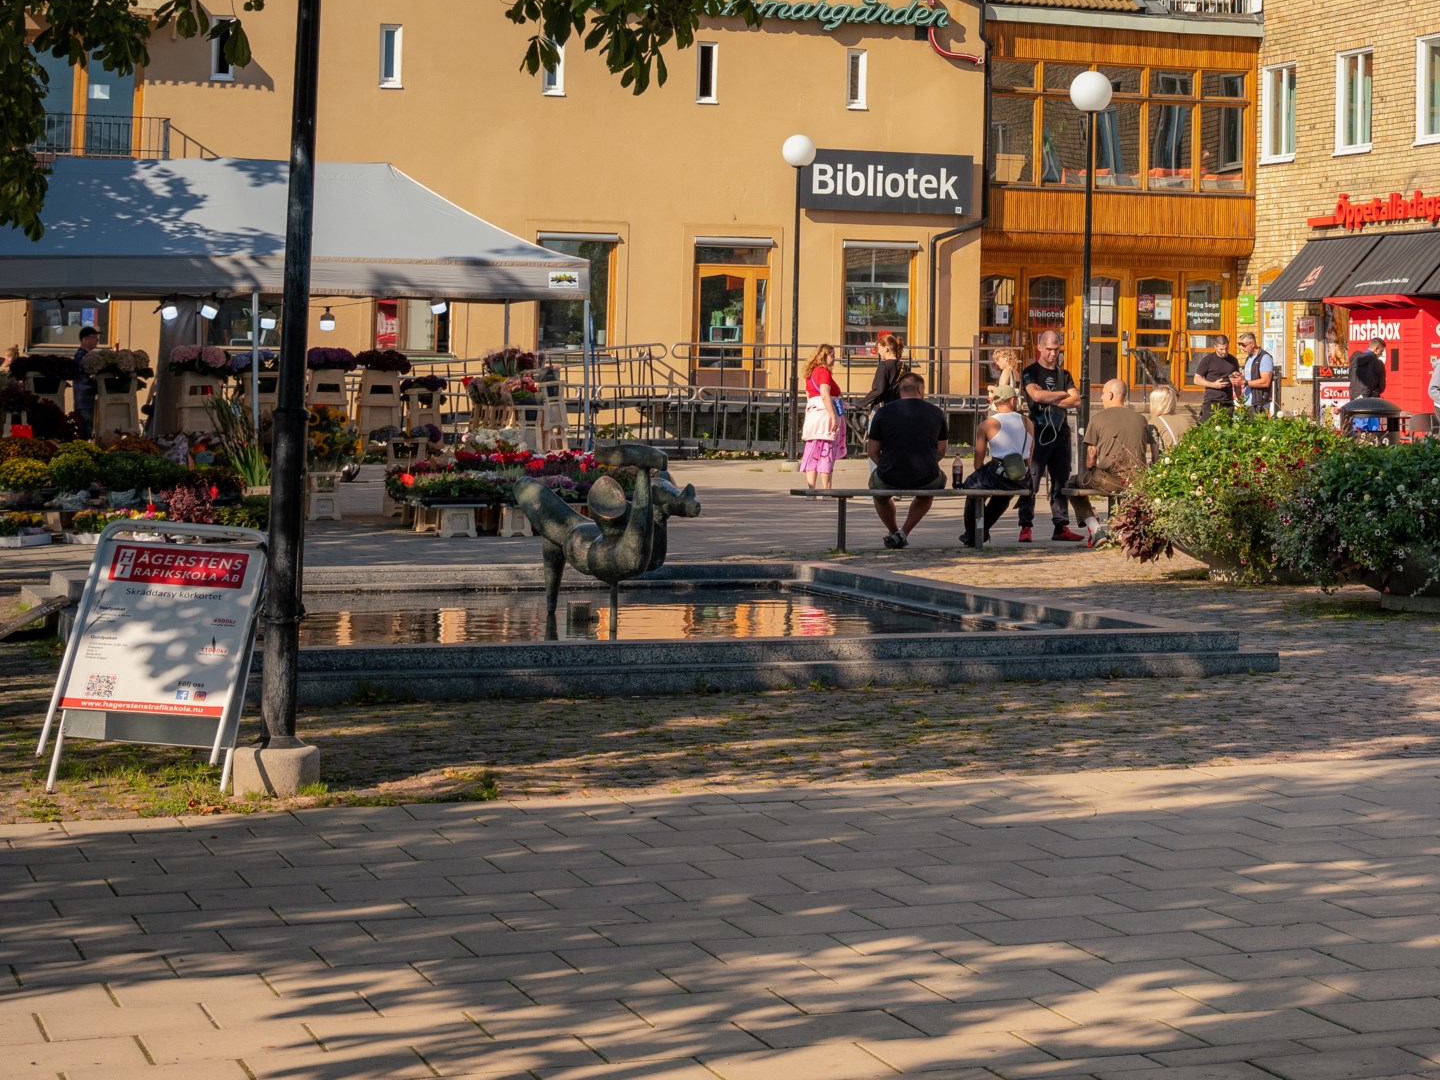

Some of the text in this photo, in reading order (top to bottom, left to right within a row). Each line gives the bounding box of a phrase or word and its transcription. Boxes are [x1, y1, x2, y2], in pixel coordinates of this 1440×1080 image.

[812, 163, 958, 200] Bibliotek
[1335, 193, 1382, 229] Öppet
[1381, 192, 1409, 220] alla
[1029, 309, 1065, 318] Bibliotek
[1193, 317, 1214, 325] gården
[1349, 316, 1401, 341] instabox
[1319, 367, 1333, 375] ICA
[1323, 387, 1350, 397] Stam
[119, 550, 243, 571] HÄGERSTENS
[118, 563, 240, 583] TRAFIKSKOLA AB
[126, 588, 222, 600] Skräddarsy körkortet
[81, 700, 203, 713] www.hagerstenstrafikskola.nu
